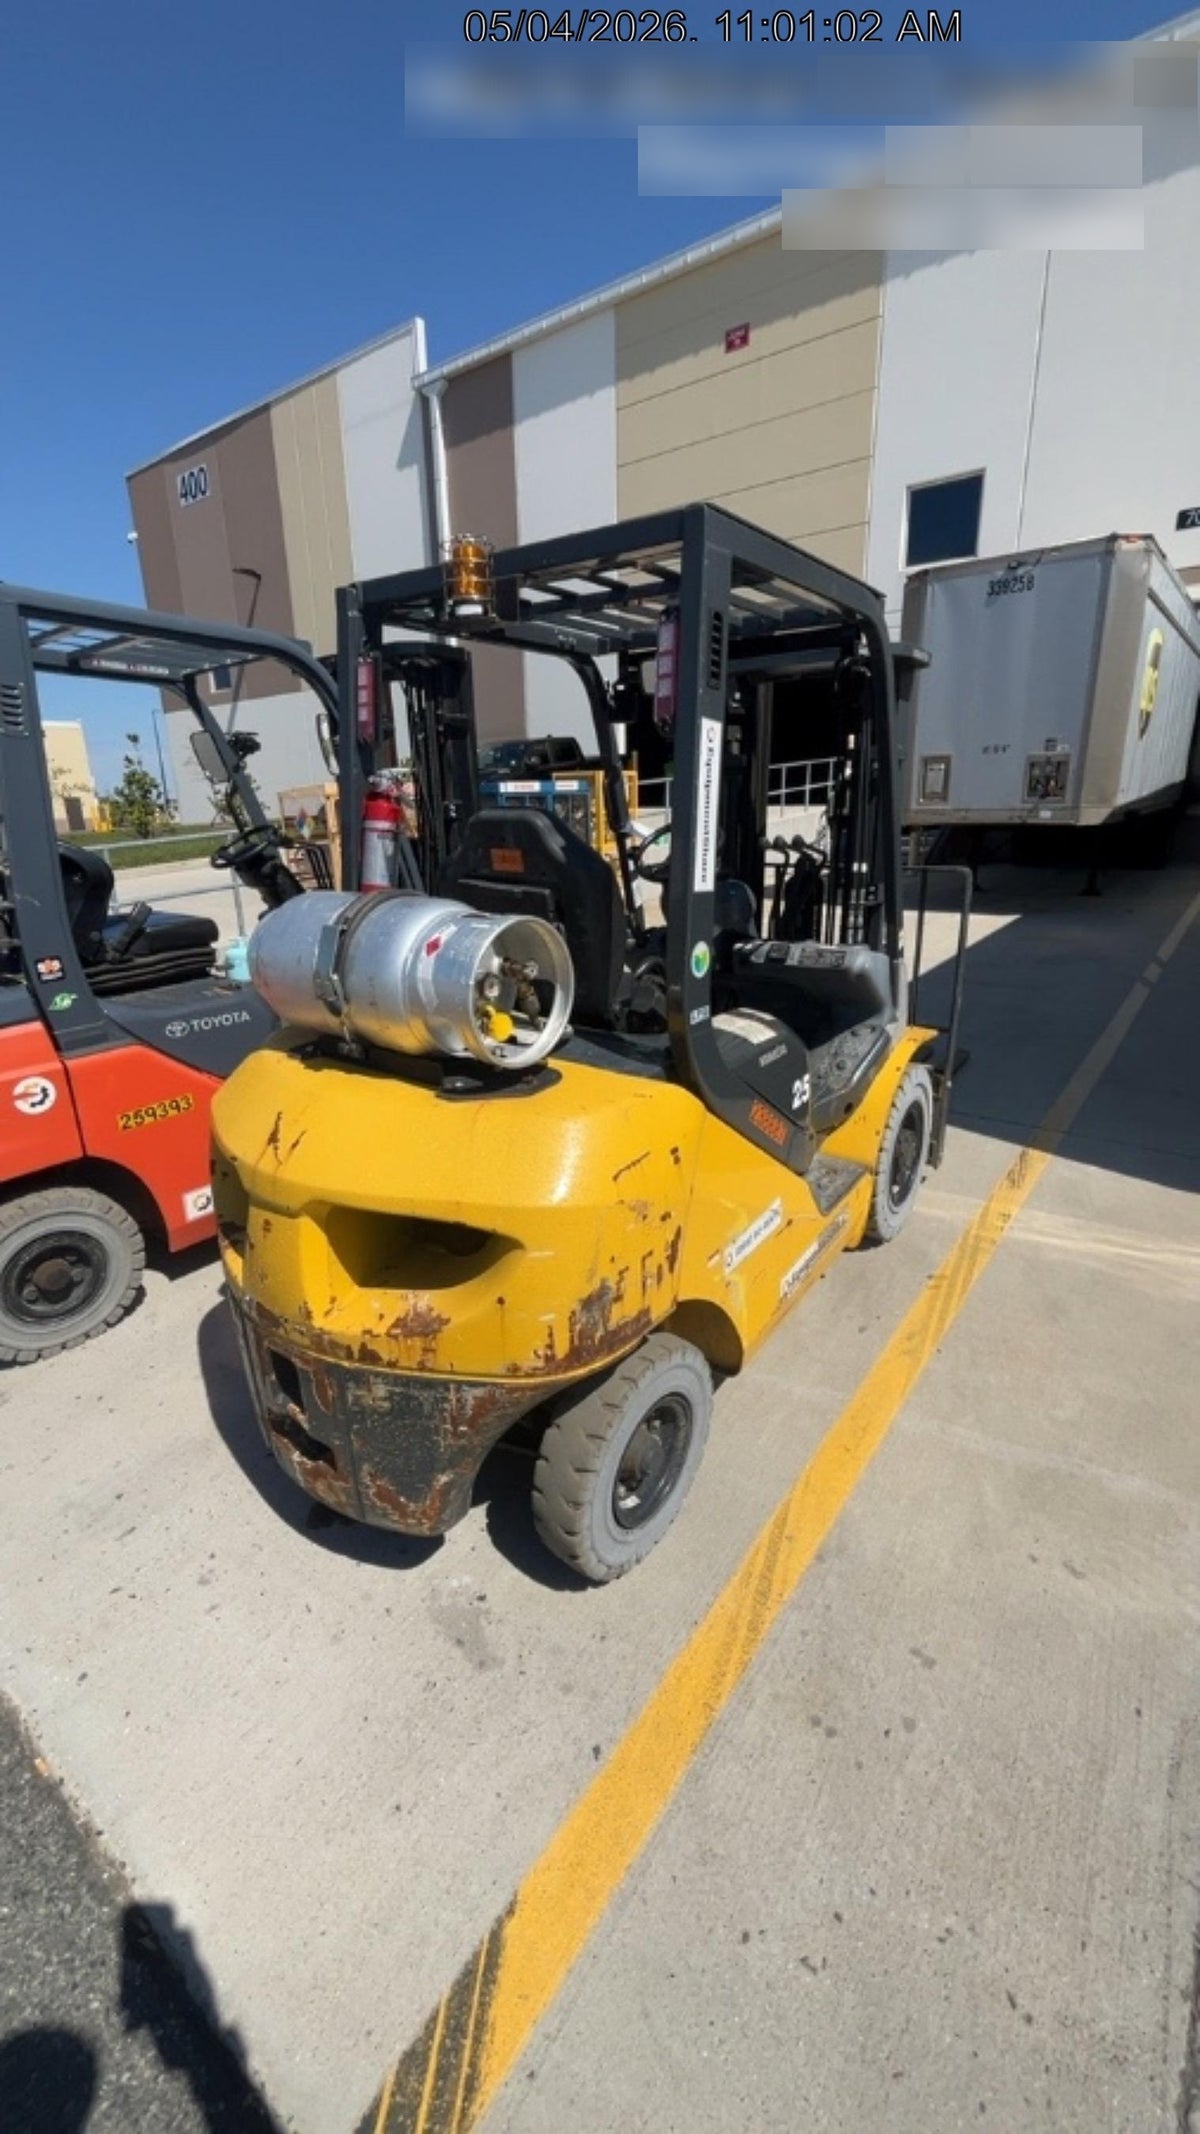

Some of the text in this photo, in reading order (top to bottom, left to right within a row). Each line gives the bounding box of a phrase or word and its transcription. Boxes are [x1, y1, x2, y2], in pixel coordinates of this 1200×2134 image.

[180, 466, 207, 503] 400
[191, 1010, 251, 1032] TOYOTA
[792, 1073, 810, 1110] 25
[120, 1095, 192, 1130] 259393
